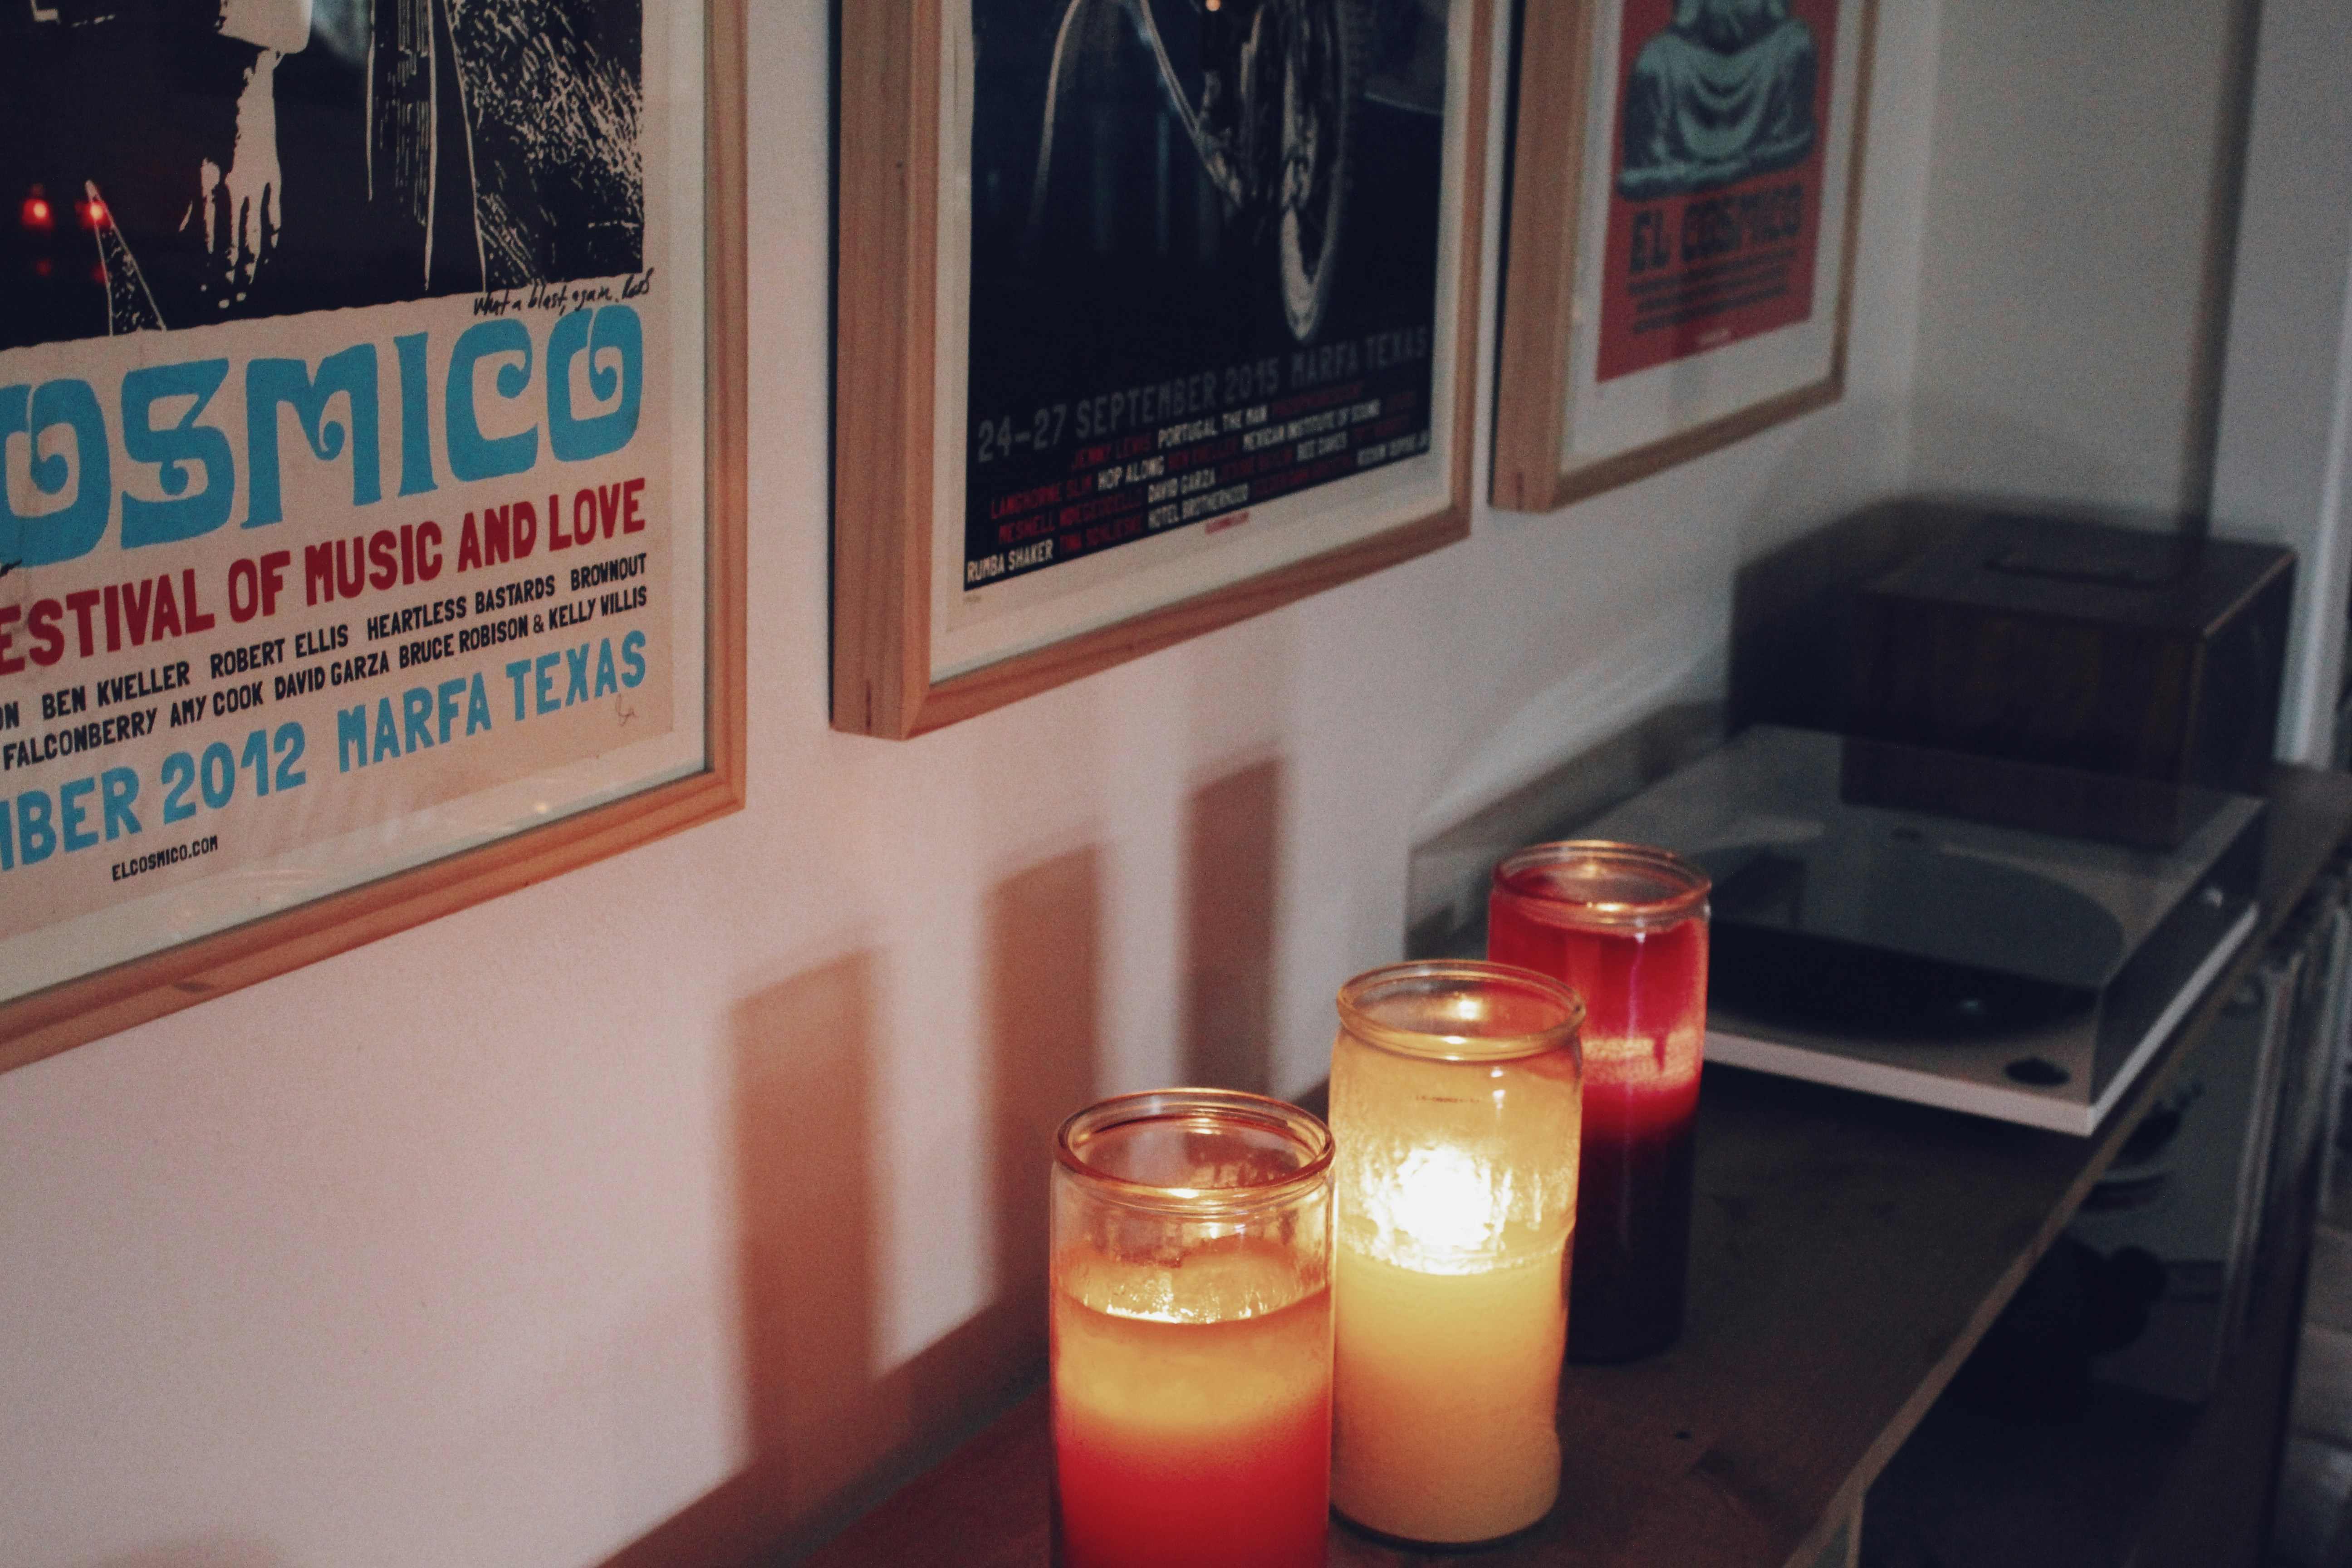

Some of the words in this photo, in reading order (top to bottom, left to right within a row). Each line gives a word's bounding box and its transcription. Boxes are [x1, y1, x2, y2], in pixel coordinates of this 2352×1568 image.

[0, 304, 643, 568] OSMICO
[1076, 370, 1217, 439] SEPTEMBER
[1224, 358, 1279, 404] 2015
[1292, 341, 1359, 389] MARFA
[1364, 325, 1429, 371] TEXAS
[967, 552, 1006, 584] RUMBA
[1008, 538, 1054, 571] SHAKER
[1098, 466, 1123, 491] HOP
[1125, 455, 1165, 484] ALONG
[0, 568, 216, 676] ESTIVAL
[228, 550, 292, 623] OF
[304, 521, 443, 606] MUSIC
[457, 500, 538, 573] AND
[549, 477, 647, 552] LOVE
[0, 701, 20, 730] N
[42, 686, 86, 720] BEN
[97, 661, 189, 707] KWELLER
[210, 638, 285, 679] ROBERT
[295, 624, 348, 658] ELLIS
[367, 596, 466, 640] HEARTLESS
[475, 575, 555, 614] BASTARDS
[571, 553, 646, 591] BROWNOUT
[3, 708, 157, 770] FALCONBERRY
[170, 696, 206, 727] AMY
[213, 681, 263, 716] COOK
[274, 666, 325, 701] DAVID
[331, 651, 389, 686] GARZA
[399, 633, 454, 668] BRUCE
[459, 615, 528, 652] ROBISON
[533, 614, 544, 633] &
[549, 598, 596, 630] KELLY
[600, 586, 647, 615] WILLIS
[161, 722, 306, 824] 2012
[338, 673, 491, 772] MARFA
[506, 631, 646, 720] TEXAS
[112, 836, 217, 881] ELCOSMICO.COM
